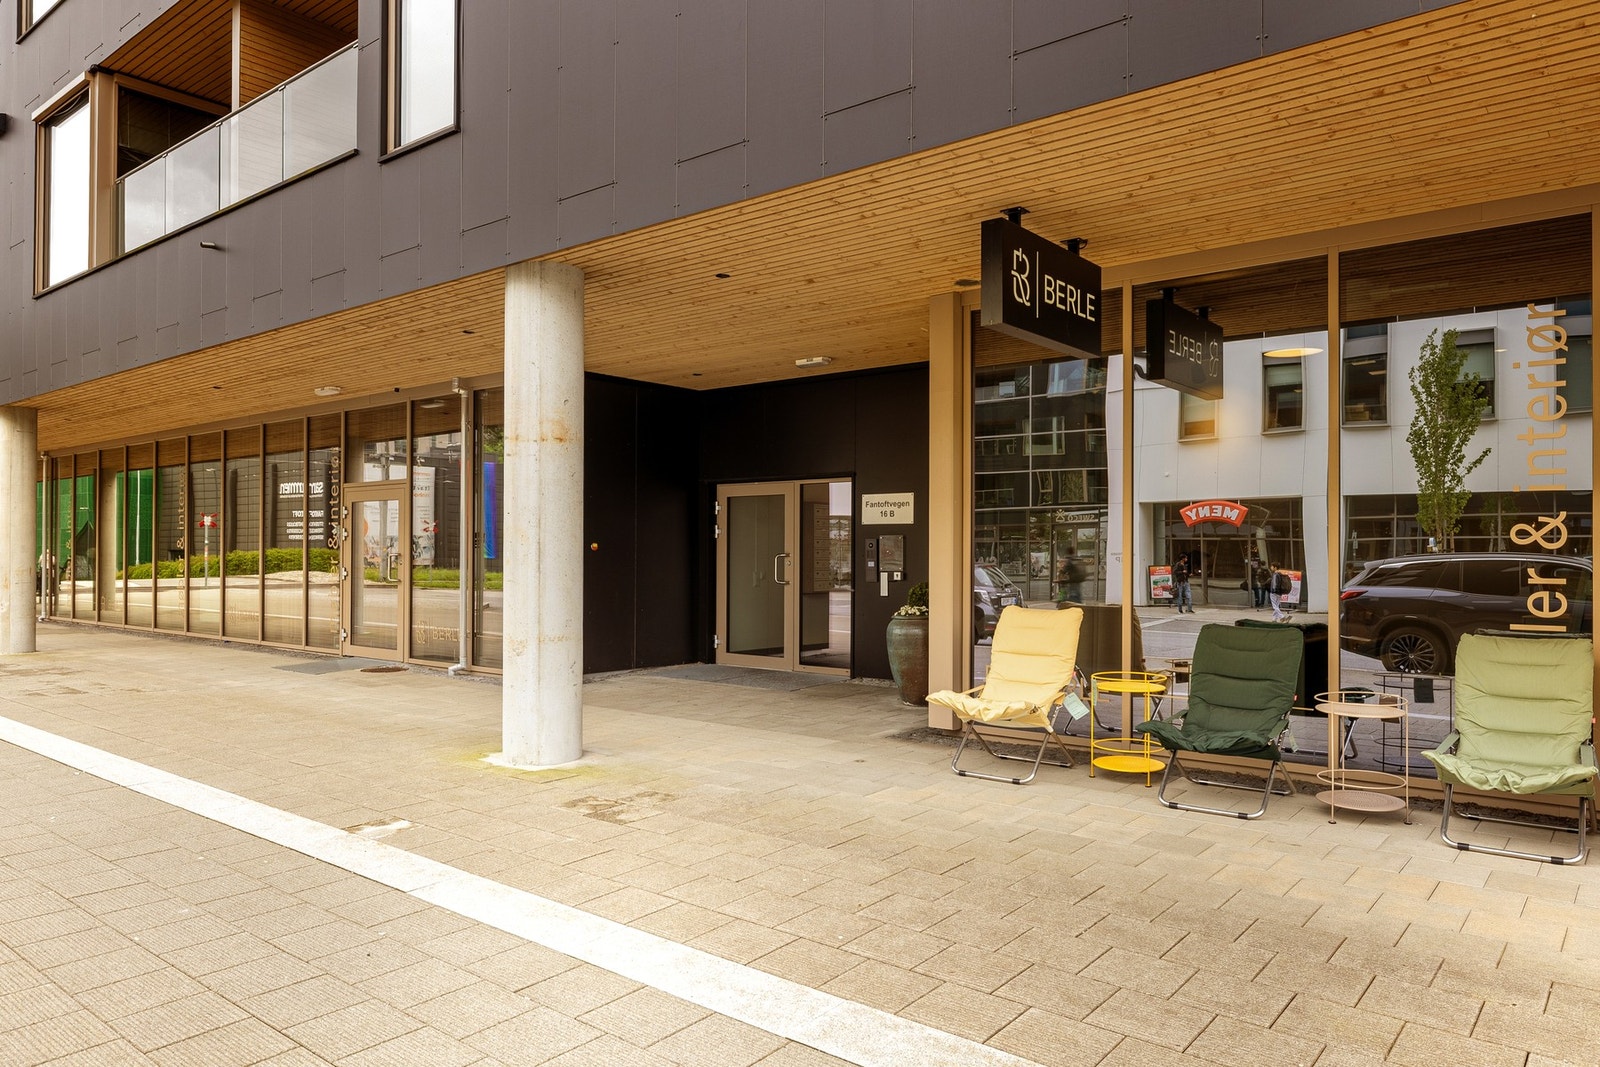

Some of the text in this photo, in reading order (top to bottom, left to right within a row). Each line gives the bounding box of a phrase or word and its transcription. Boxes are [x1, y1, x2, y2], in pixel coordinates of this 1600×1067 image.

[1044, 274, 1096, 322] BERLE
[1510, 303, 1568, 633] ler & interiør
[865, 500, 910, 509] Fantoftvegen
[432, 626, 460, 642] BERL
